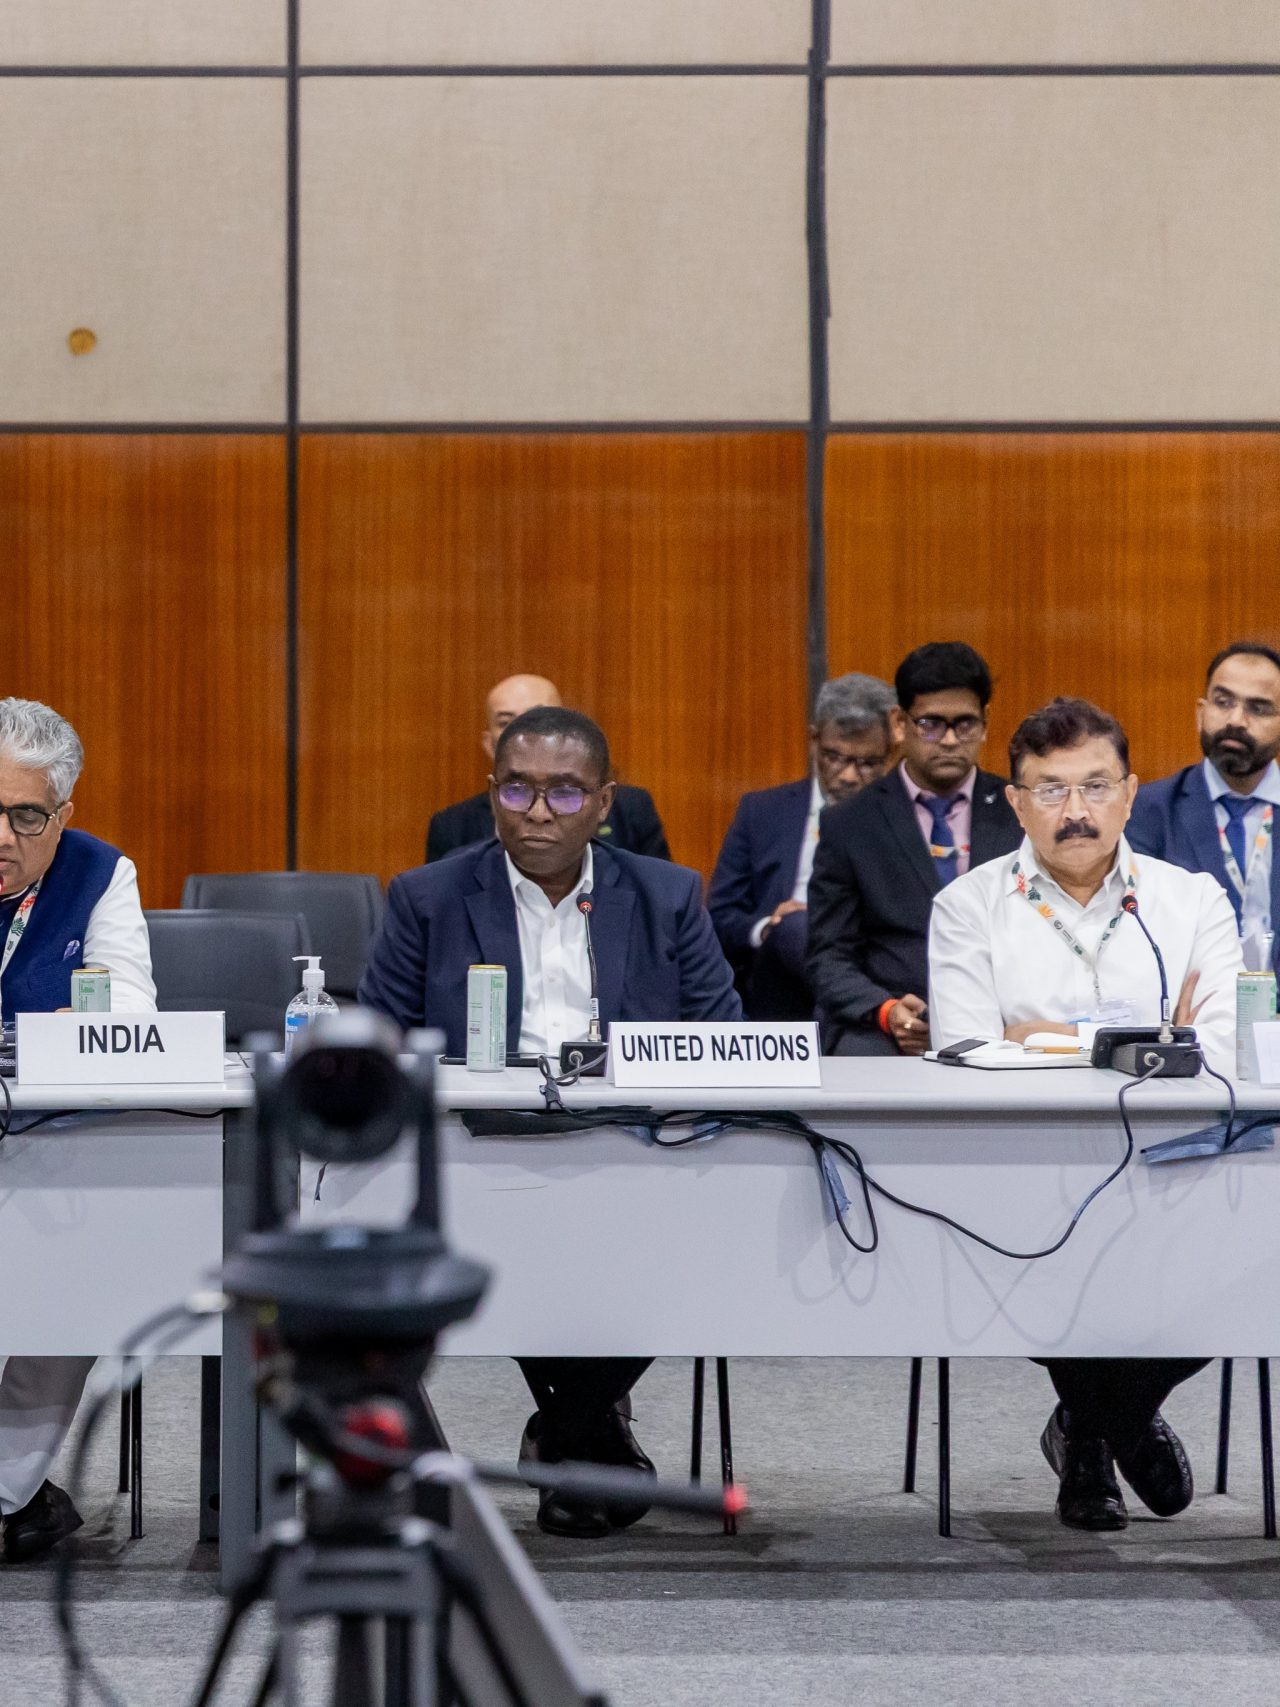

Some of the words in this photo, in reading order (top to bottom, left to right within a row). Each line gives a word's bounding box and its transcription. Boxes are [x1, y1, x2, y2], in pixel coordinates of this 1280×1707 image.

[79, 1024, 165, 1053] INDIA
[621, 1034, 705, 1062] UNITED
[711, 1034, 810, 1062] NATIONS
